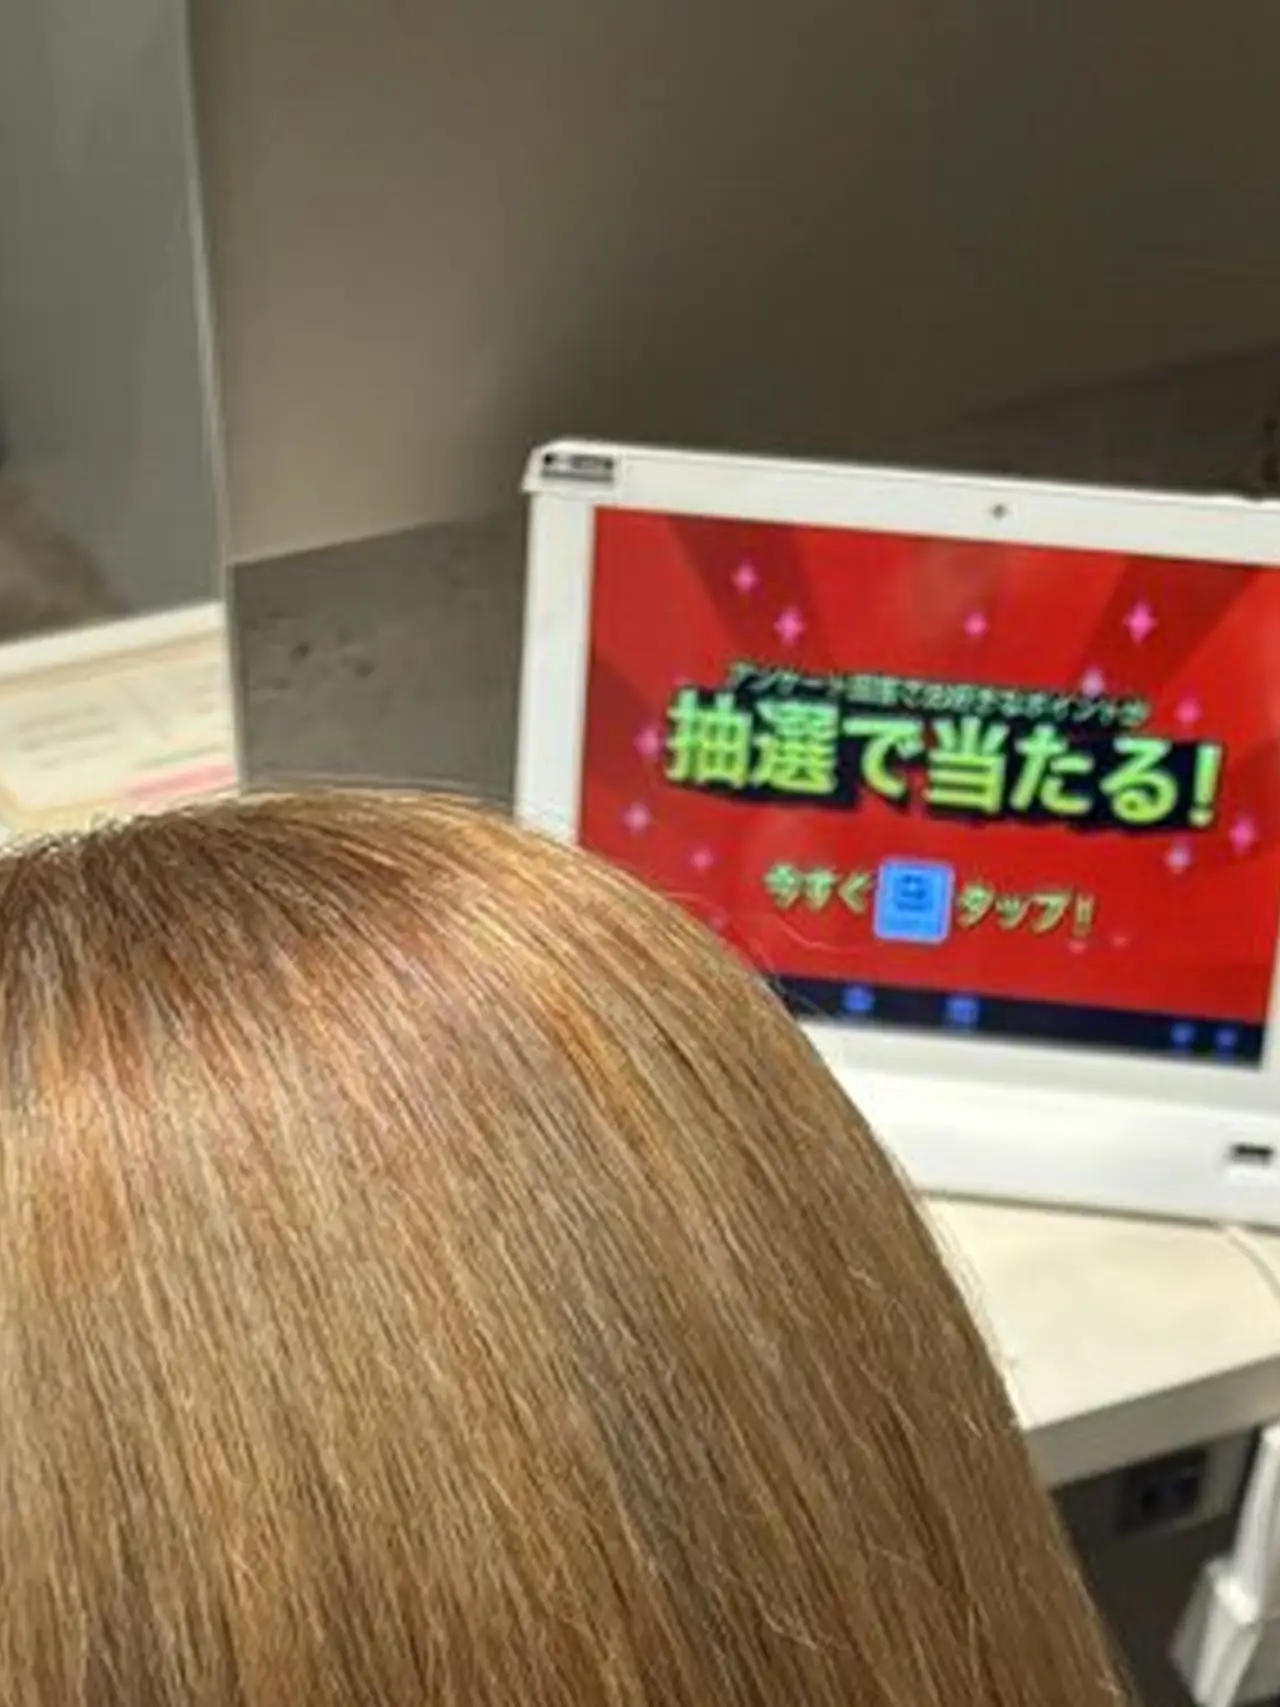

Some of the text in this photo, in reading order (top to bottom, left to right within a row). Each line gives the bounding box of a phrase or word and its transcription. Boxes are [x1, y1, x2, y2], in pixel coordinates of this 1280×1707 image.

[666, 688, 1222, 828] 抽選で当たる!
[763, 863, 869, 915] 今すぐ
